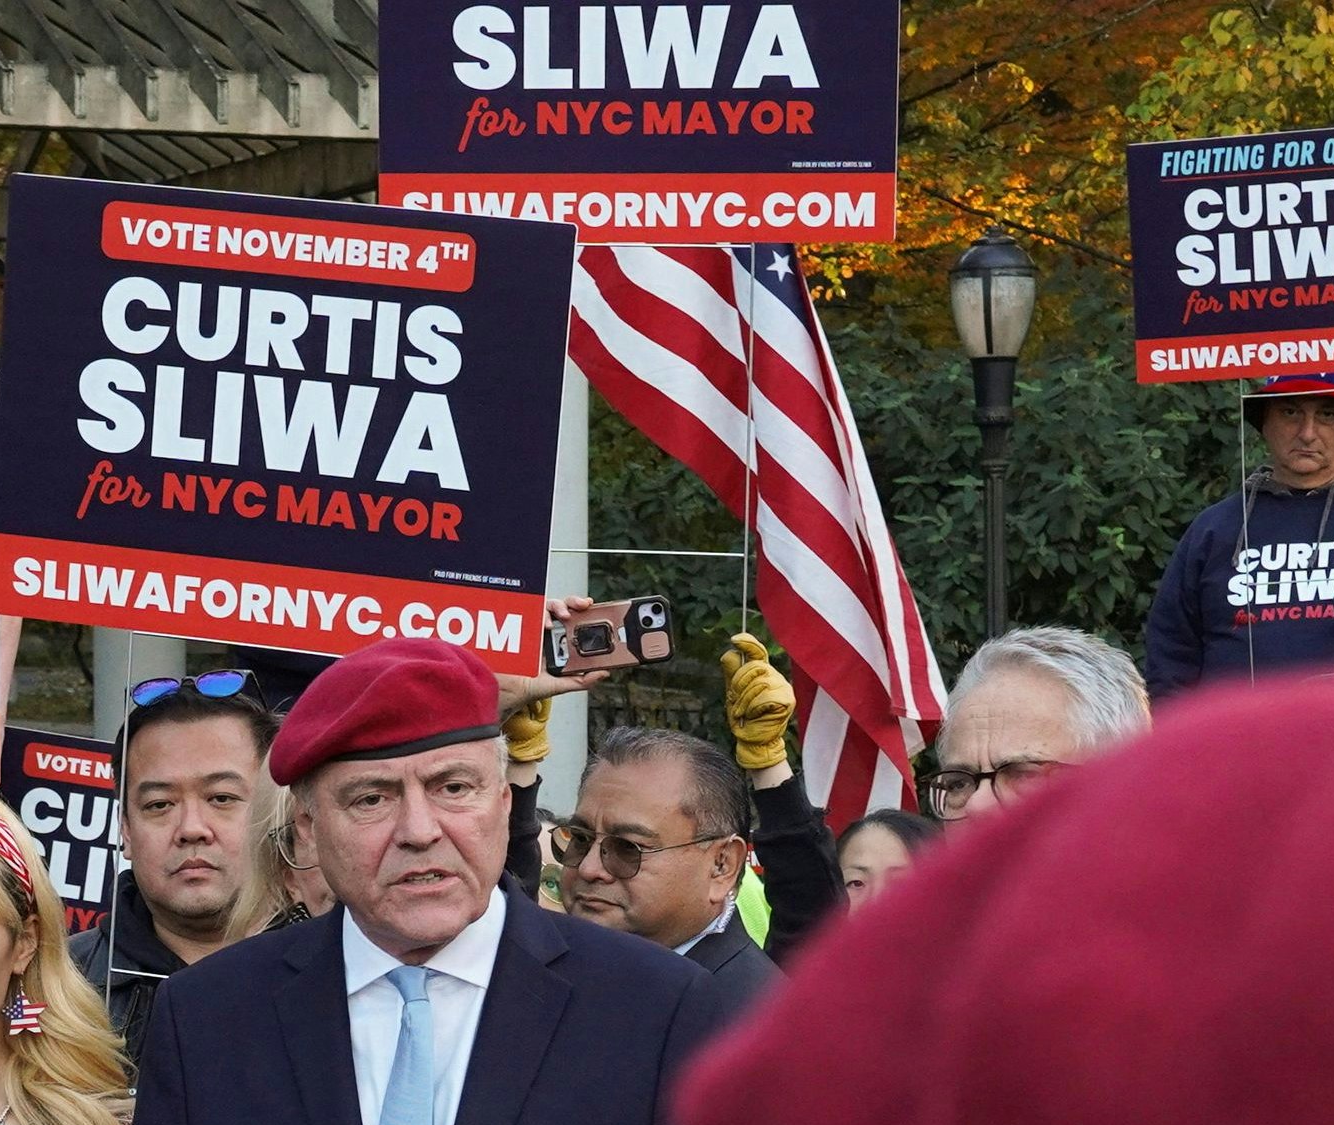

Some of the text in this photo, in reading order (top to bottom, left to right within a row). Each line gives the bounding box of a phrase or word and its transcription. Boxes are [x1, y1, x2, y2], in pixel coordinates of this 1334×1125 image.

[453, 5, 819, 90] SLIWA
[459, 97, 814, 152] for NYC MAYOR
[1161, 144, 1264, 176] FIGHTING
[1272, 141, 1315, 168] FOR
[122, 217, 468, 273] VOTE NOVEMBER 4TH
[102, 277, 462, 384] CURTIS
[1183, 290, 1223, 324] for
[1229, 288, 1288, 310] NYC
[77, 359, 470, 491] SLIWA
[76, 460, 462, 540] for NYC MAYOR
[13, 557, 522, 653] SLIWAFORNYC.COM
[1261, 606, 1302, 622] NYC
[37, 752, 92, 776] VOTE
